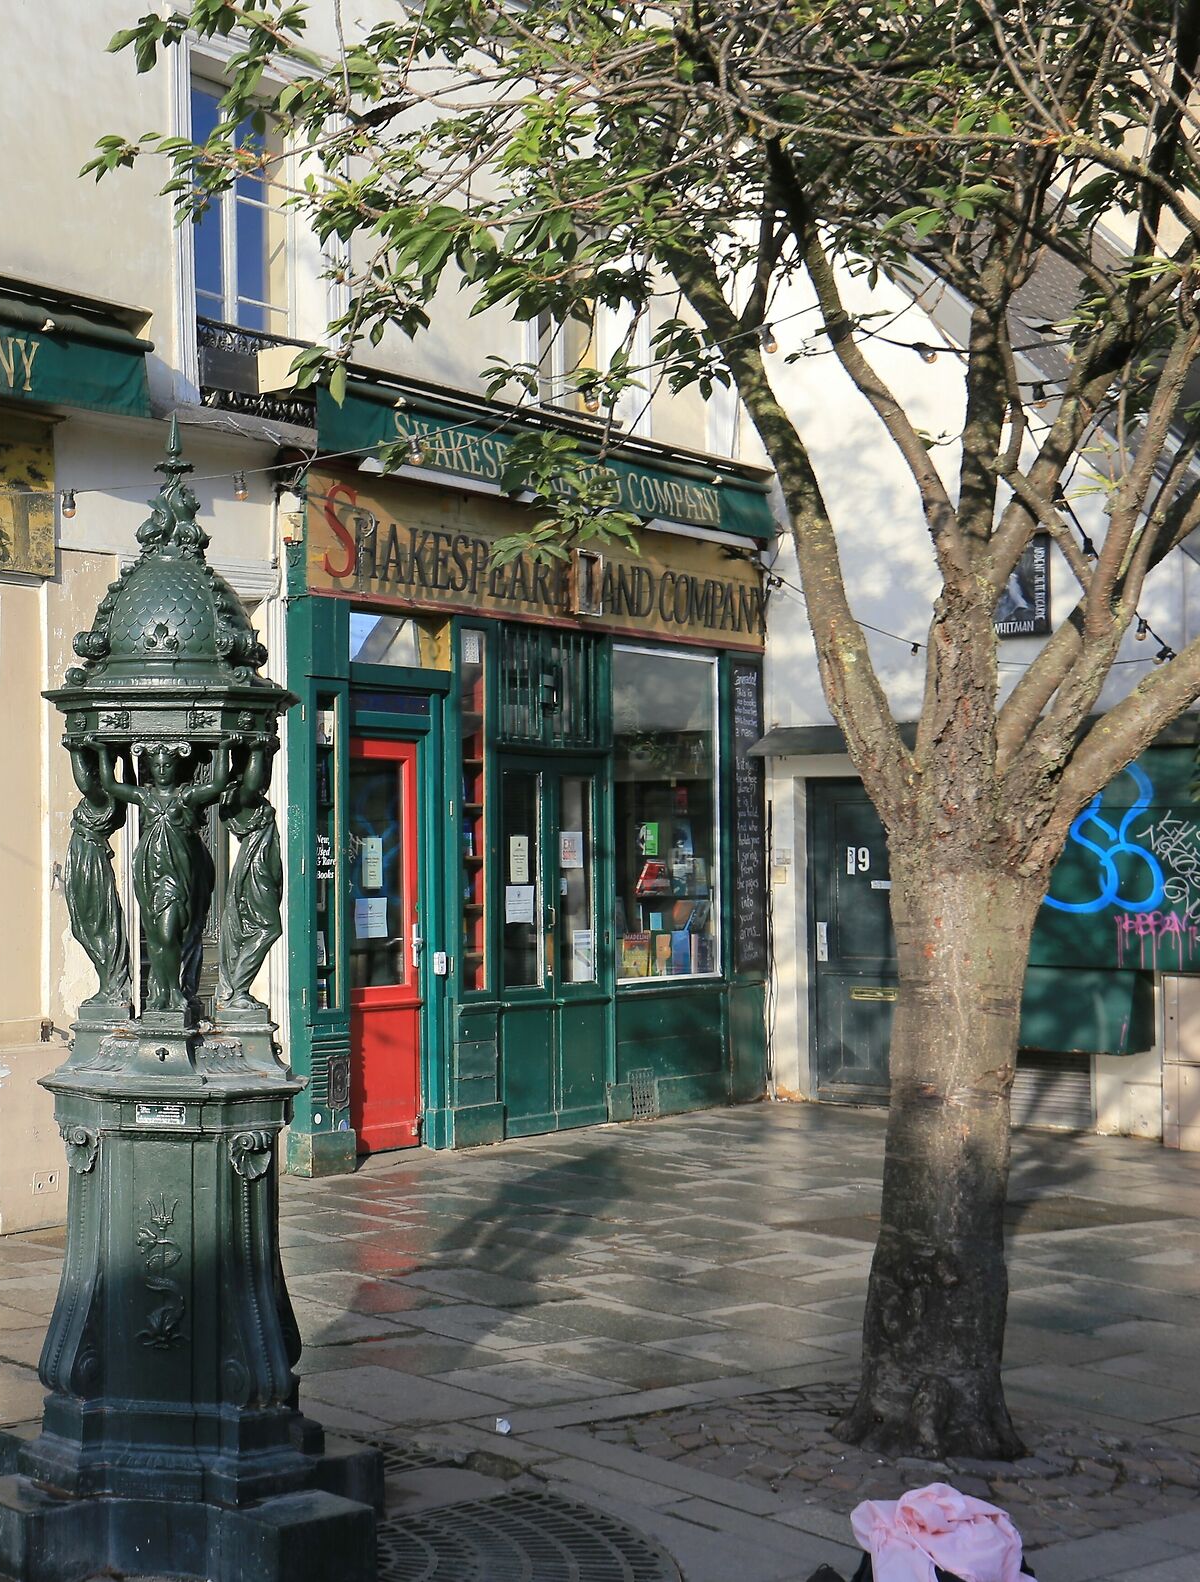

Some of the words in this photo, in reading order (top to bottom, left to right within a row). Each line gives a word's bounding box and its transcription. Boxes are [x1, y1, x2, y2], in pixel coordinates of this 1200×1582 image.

[627, 472, 721, 524] COMPANY
[601, 561, 655, 617] AND
[658, 570, 771, 635] COMPANY
[317, 869, 335, 880] Books
